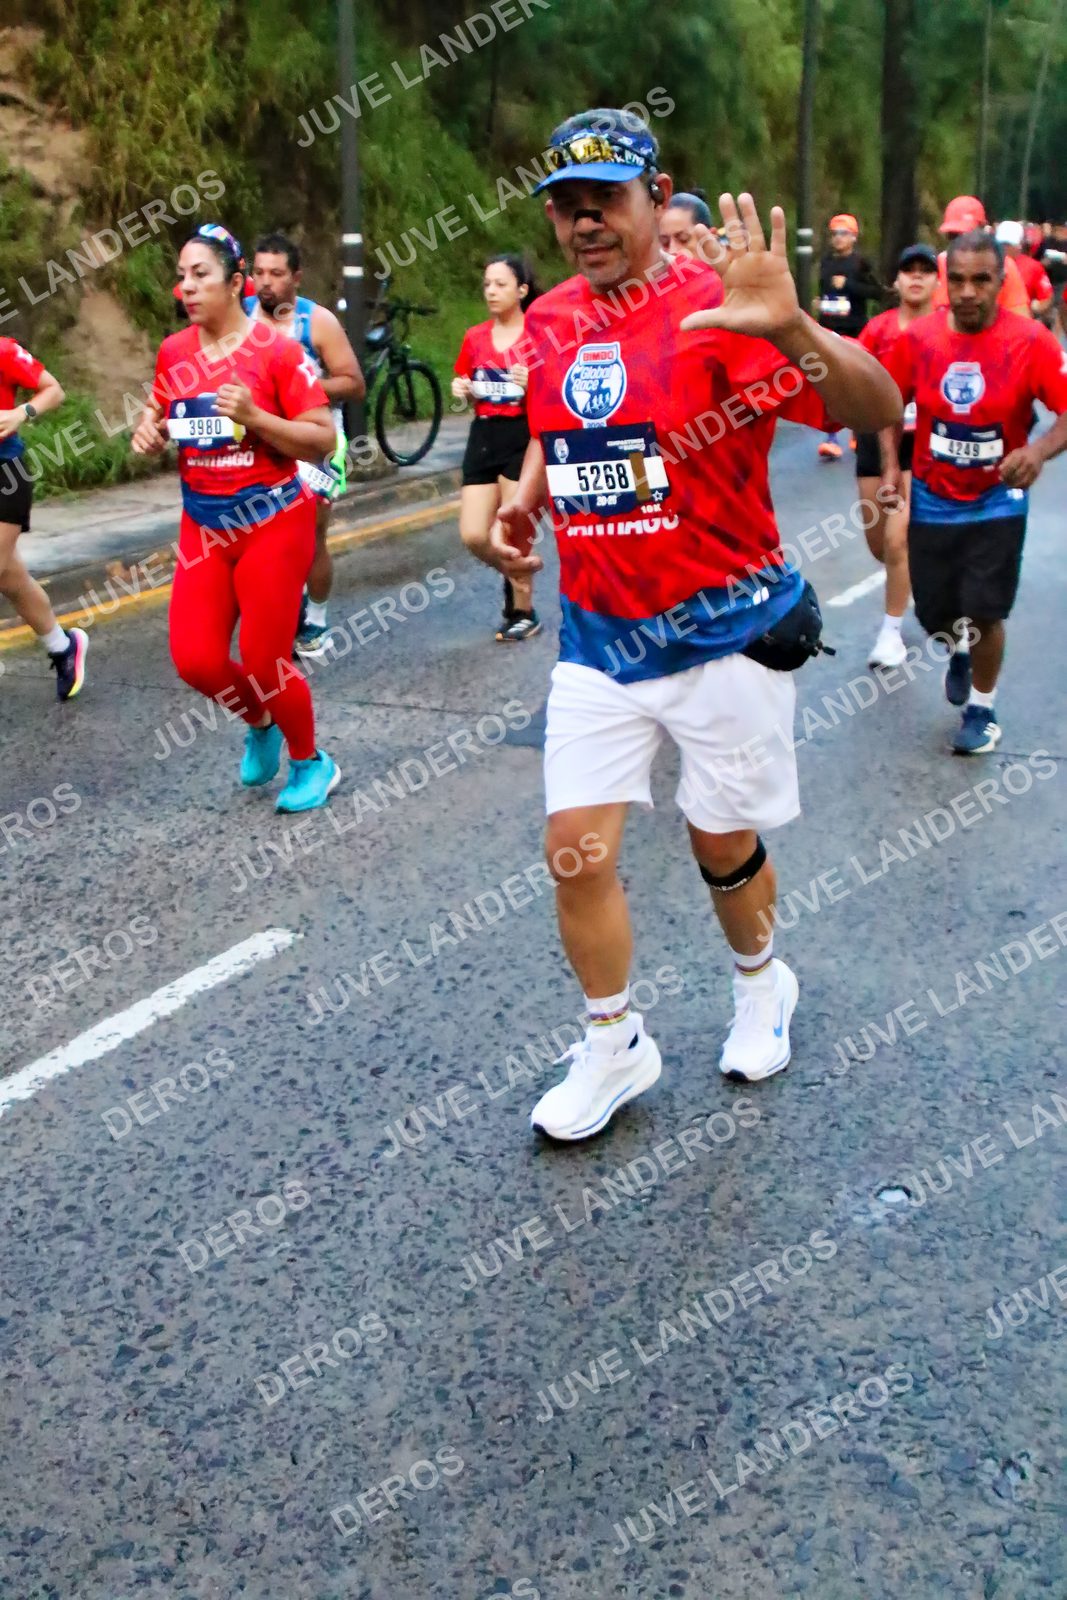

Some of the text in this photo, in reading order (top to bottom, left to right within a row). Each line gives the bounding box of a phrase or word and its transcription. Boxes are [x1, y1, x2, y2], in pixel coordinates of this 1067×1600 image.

[579, 366, 612, 380] Global
[572, 378, 600, 392] Race
[189, 418, 222, 436] 3980
[948, 440, 980, 457] 4249
[577, 462, 630, 492] 5268
[641, 503, 663, 514] 10K
